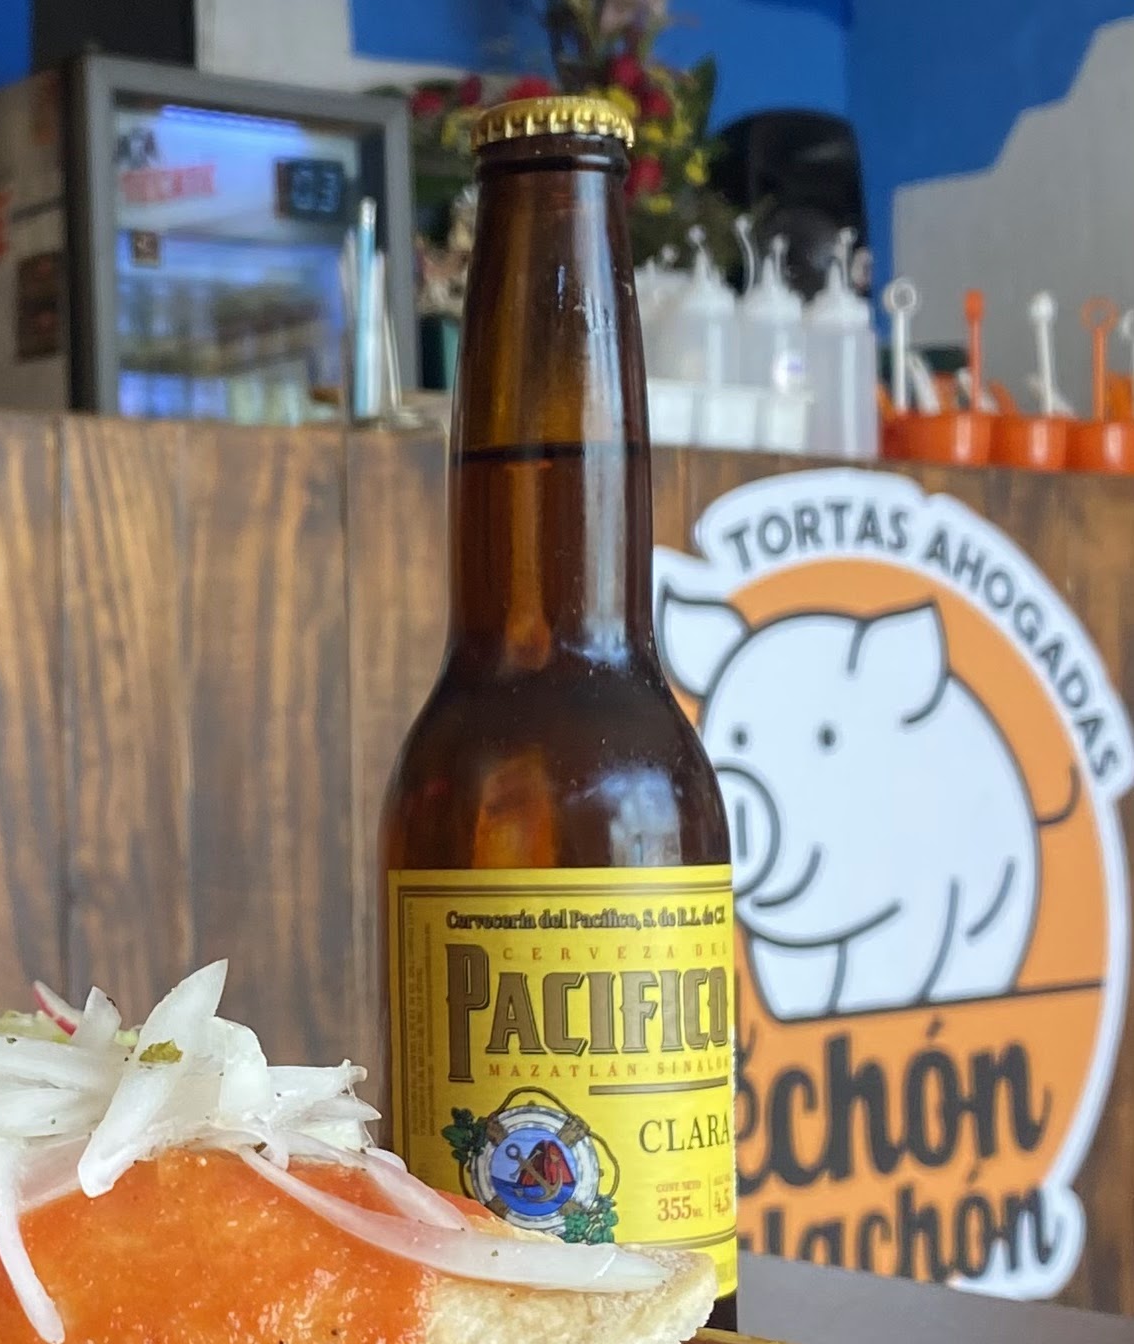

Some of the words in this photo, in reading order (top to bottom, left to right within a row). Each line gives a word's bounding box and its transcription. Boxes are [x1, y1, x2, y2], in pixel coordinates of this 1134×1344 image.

[722, 500, 908, 573] TORTAS
[922, 527, 1121, 779] AHOGADAS
[538, 908, 567, 930] del
[657, 908, 676, 928] de
[502, 946, 675, 961] CERVEZA
[445, 943, 729, 1084] PACIFICO
[487, 1058, 638, 1078] MAZATLÁN
[638, 1112, 730, 1154] CLARA
[657, 1194, 692, 1222] 355
